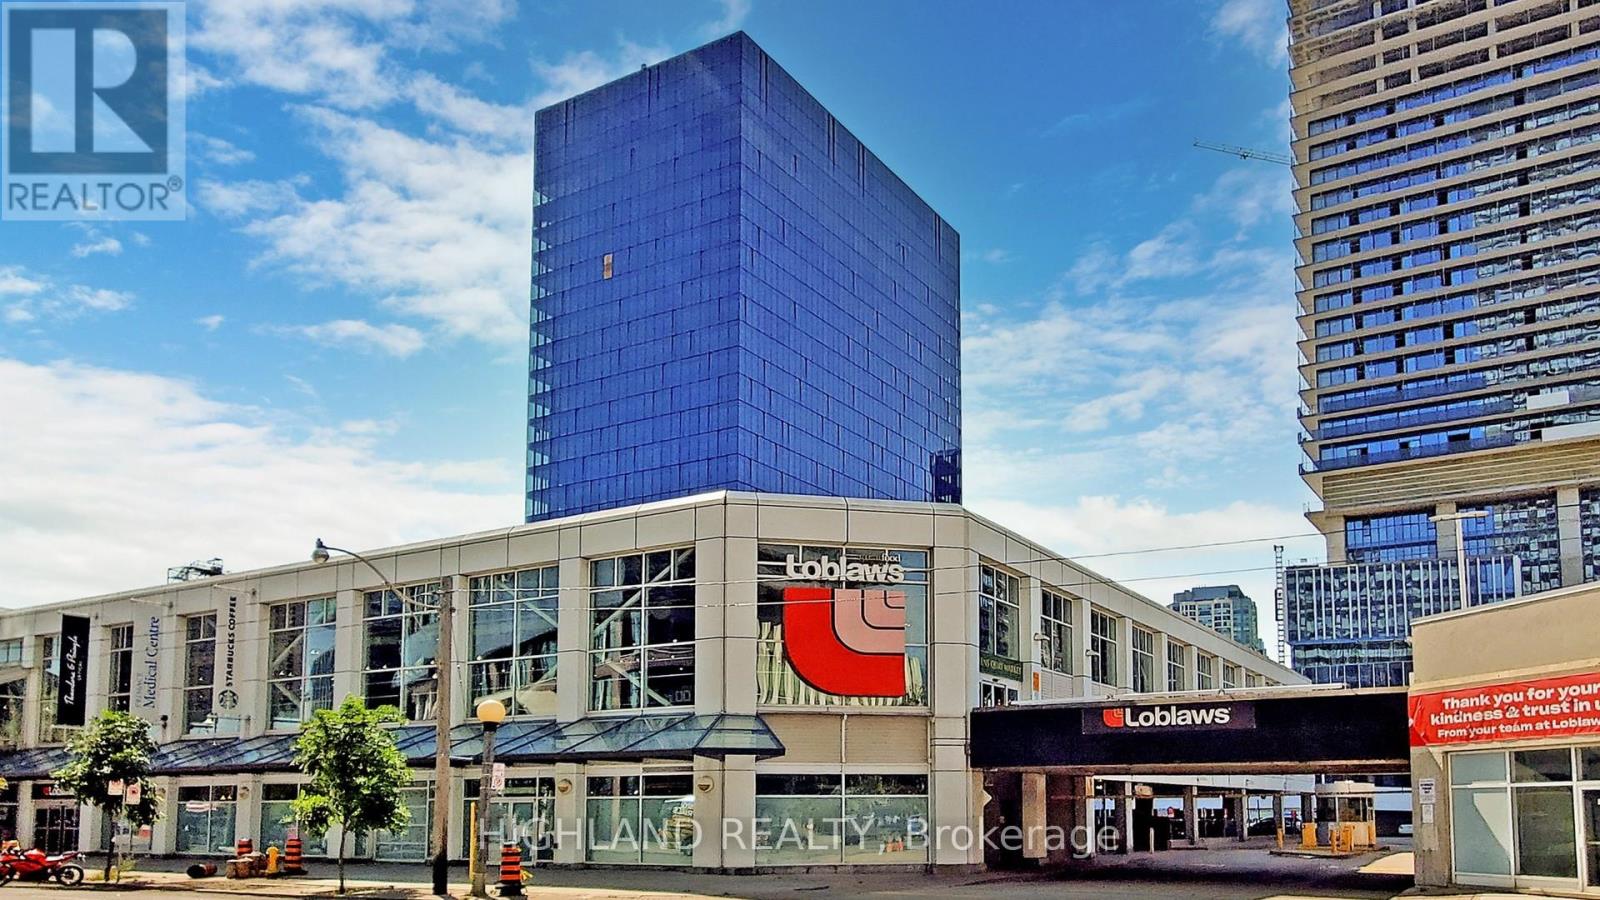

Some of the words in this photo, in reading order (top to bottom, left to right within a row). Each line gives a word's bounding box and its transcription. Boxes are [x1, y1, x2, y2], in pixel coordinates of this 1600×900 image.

[228, 596, 237, 631] COFFEE
[145, 616, 160, 657] Centre
[226, 632, 236, 687] STARBUCKS
[143, 660, 157, 708] Medical
[1442, 694, 1491, 710] Thank
[1493, 691, 1524, 708] you
[1527, 687, 1556, 701] for
[1557, 682, 1600, 701] your
[1125, 705, 1232, 727] Loblaws
[1430, 708, 1503, 726] kindness
[1505, 706, 1520, 718] &
[1522, 700, 1571, 717] trust
[1573, 698, 1592, 713] in
[1437, 727, 1467, 738] From
[1468, 725, 1497, 739] your
[1499, 721, 1533, 733] team
[1535, 719, 1551, 730] at
